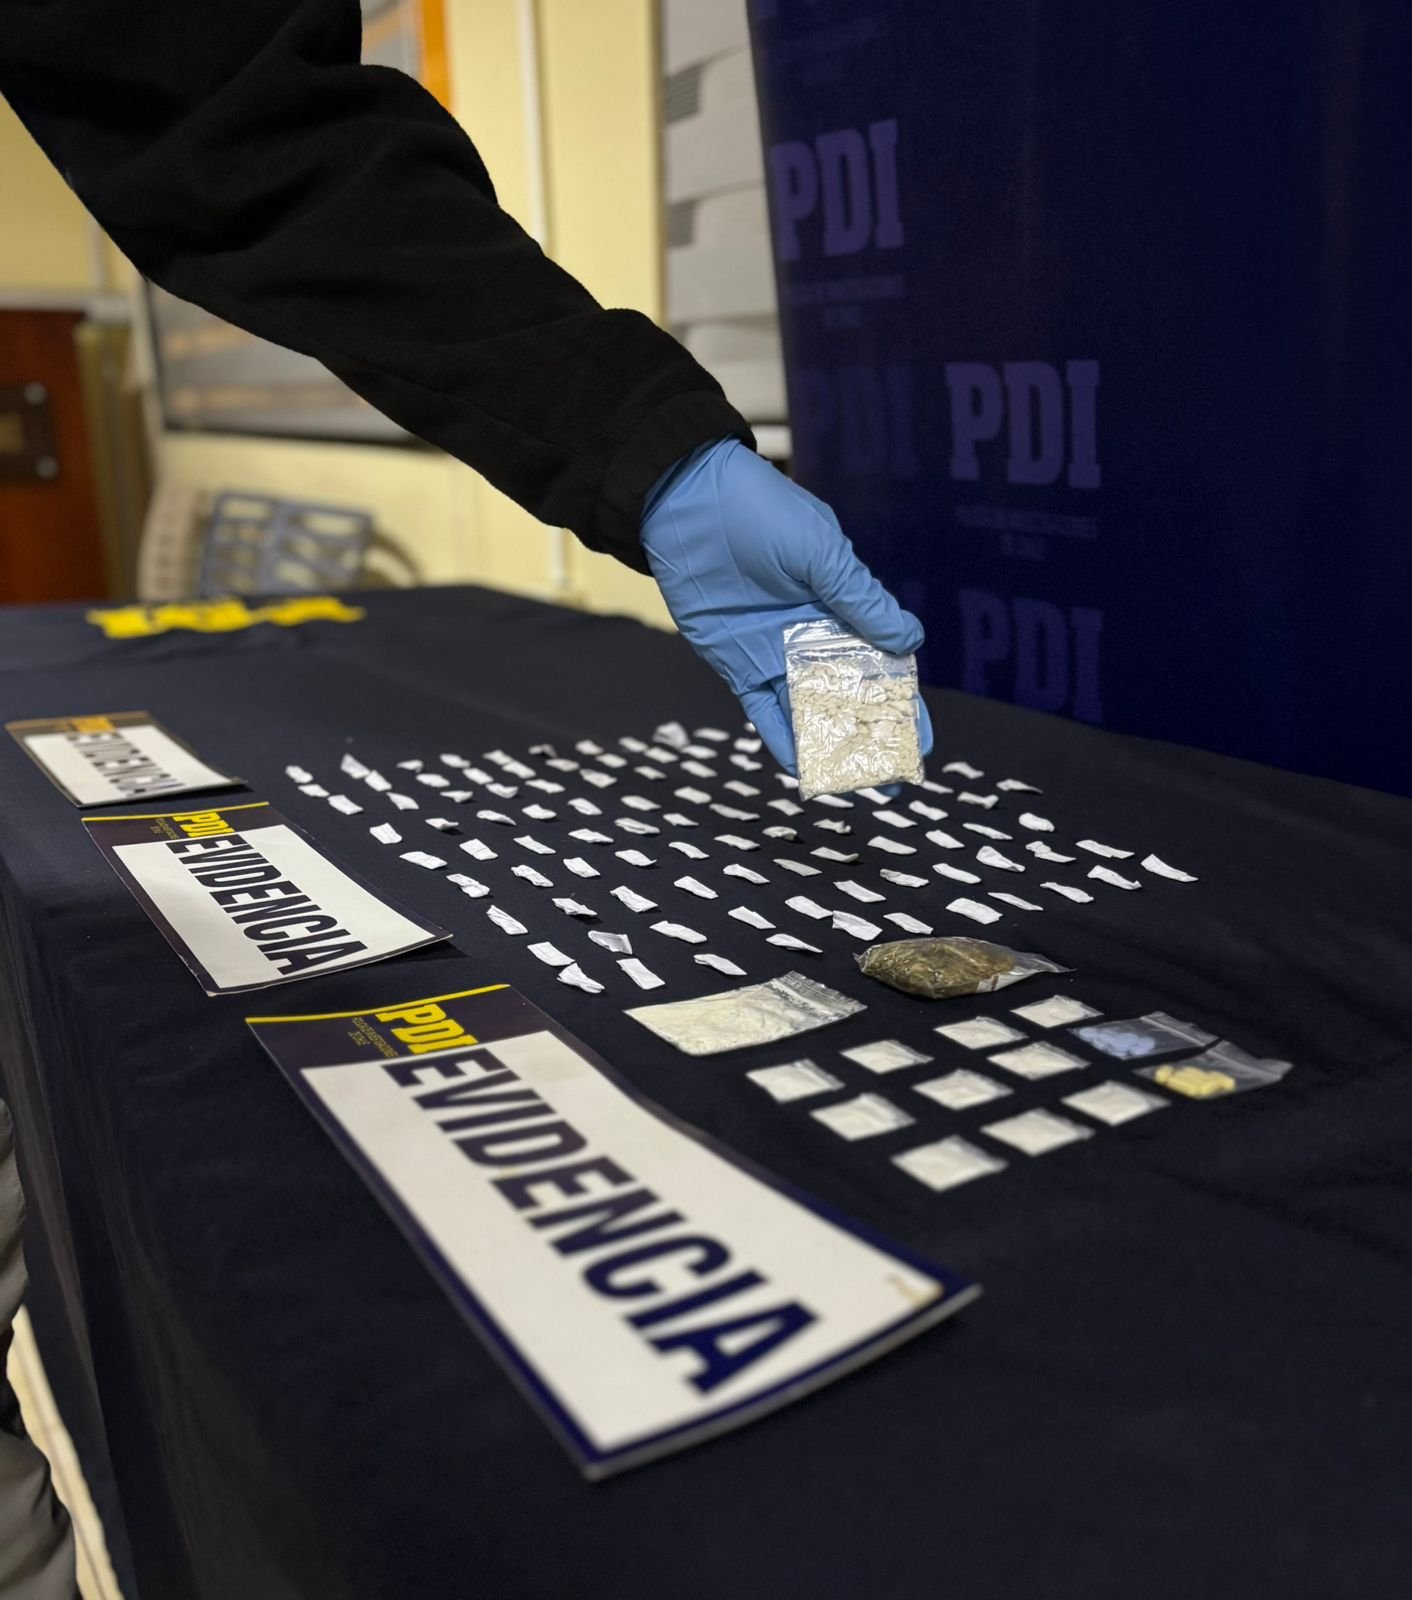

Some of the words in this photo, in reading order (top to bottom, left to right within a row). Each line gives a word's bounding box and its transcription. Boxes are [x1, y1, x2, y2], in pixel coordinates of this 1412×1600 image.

[770, 118, 905, 262] PDI
[945, 359, 1101, 488] PDI
[958, 588, 1104, 723] PDI
[172, 812, 235, 837] PDI
[165, 834, 368, 975] EVIDENCIA
[375, 1003, 478, 1054] PDI
[380, 1047, 821, 1394] EVIDENCIA
